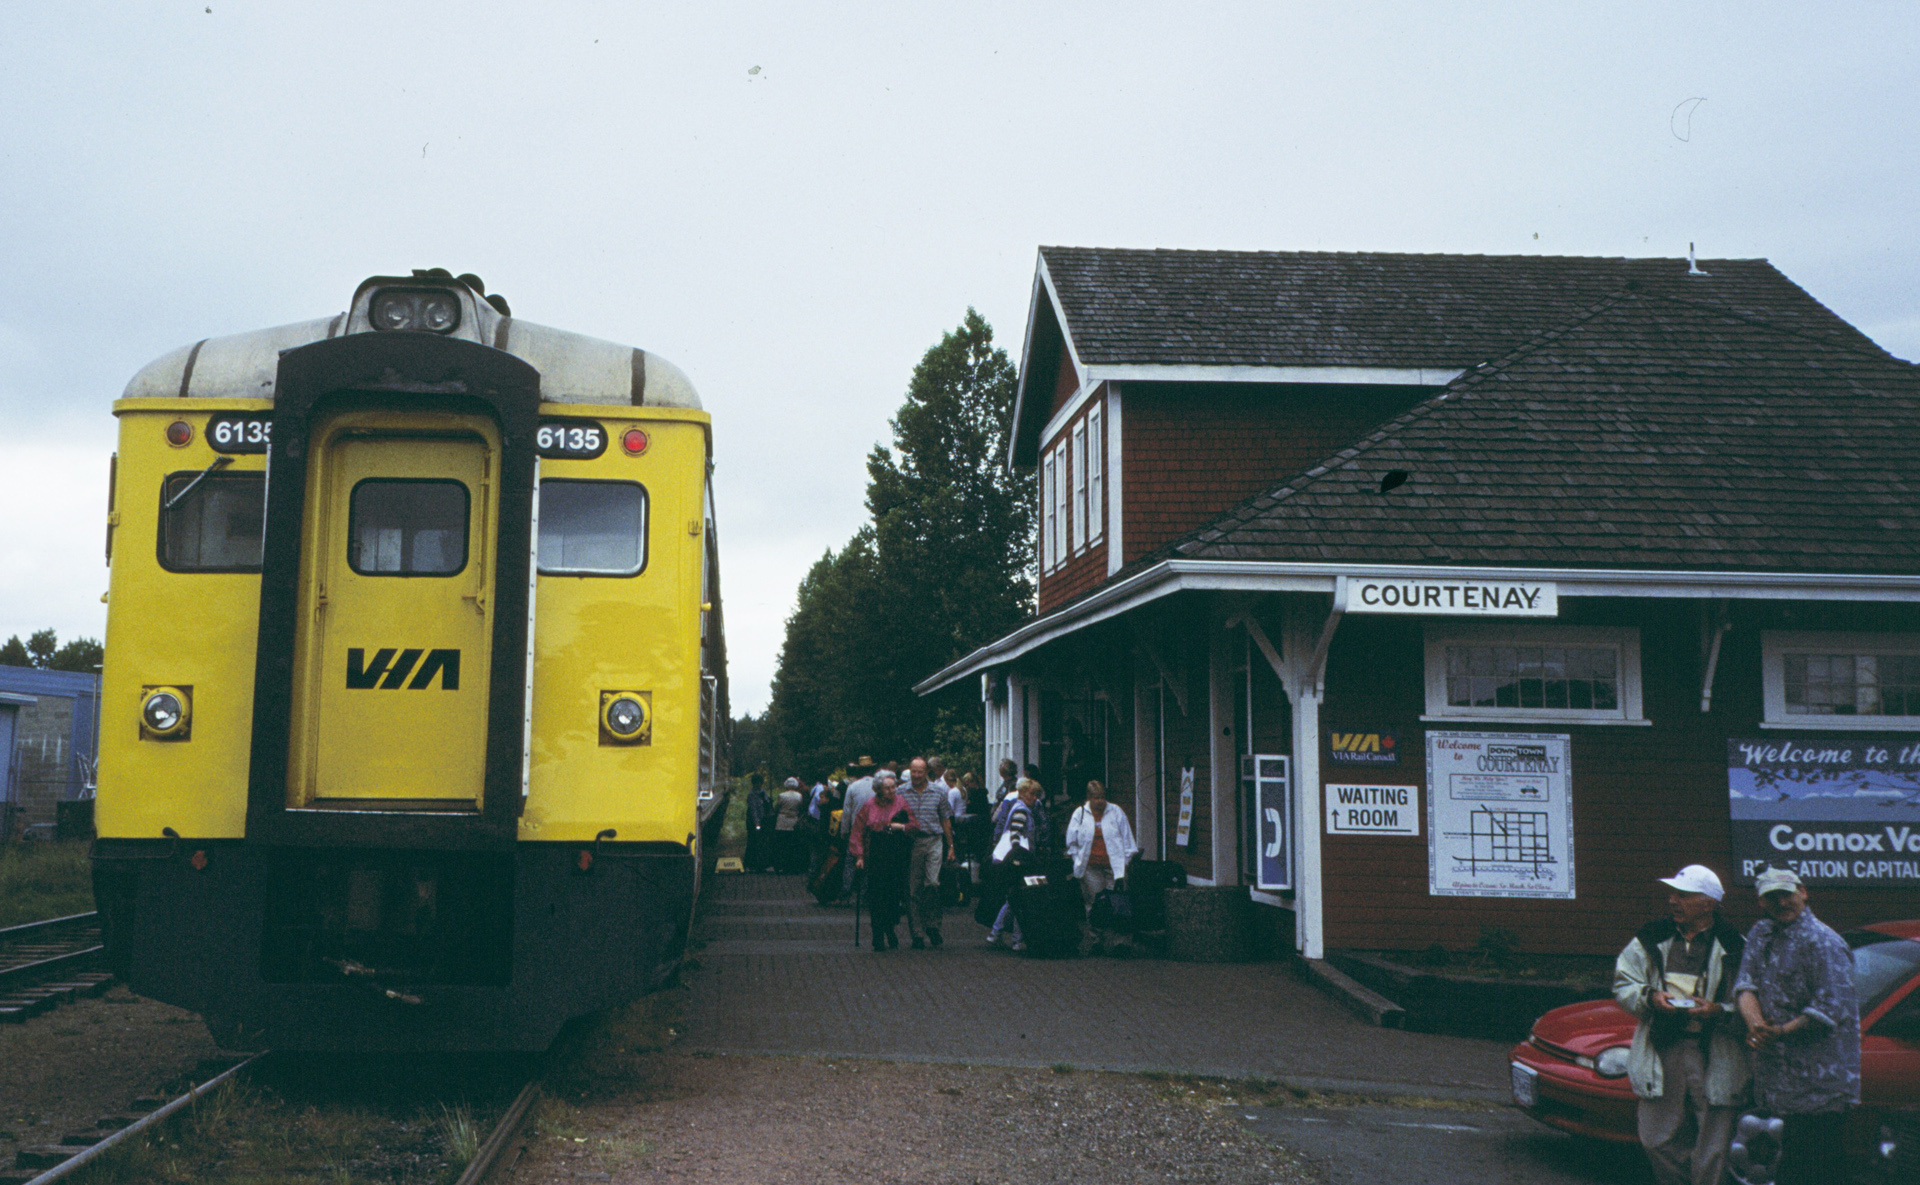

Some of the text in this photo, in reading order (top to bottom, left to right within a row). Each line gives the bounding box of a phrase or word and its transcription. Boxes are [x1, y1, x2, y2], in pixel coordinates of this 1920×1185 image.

[537, 427, 600, 450] 6135
[1361, 584, 1541, 609] COURTENAY
[346, 648, 460, 690] VIA
[1332, 733, 1380, 751] VIA
[1436, 740, 1481, 750] Welcome
[1332, 752, 1349, 760] VIA
[1351, 752, 1365, 760] Rail
[1454, 752, 1463, 760] to
[1740, 743, 1851, 765] Welcome
[1865, 746, 1888, 763] to
[1477, 755, 1559, 773] COURTENAY
[1338, 788, 1408, 805] WAITING
[1348, 809, 1398, 826] ROOM
[1769, 825, 1885, 852] Comox
[1853, 861, 1920, 879] CAPITAL
